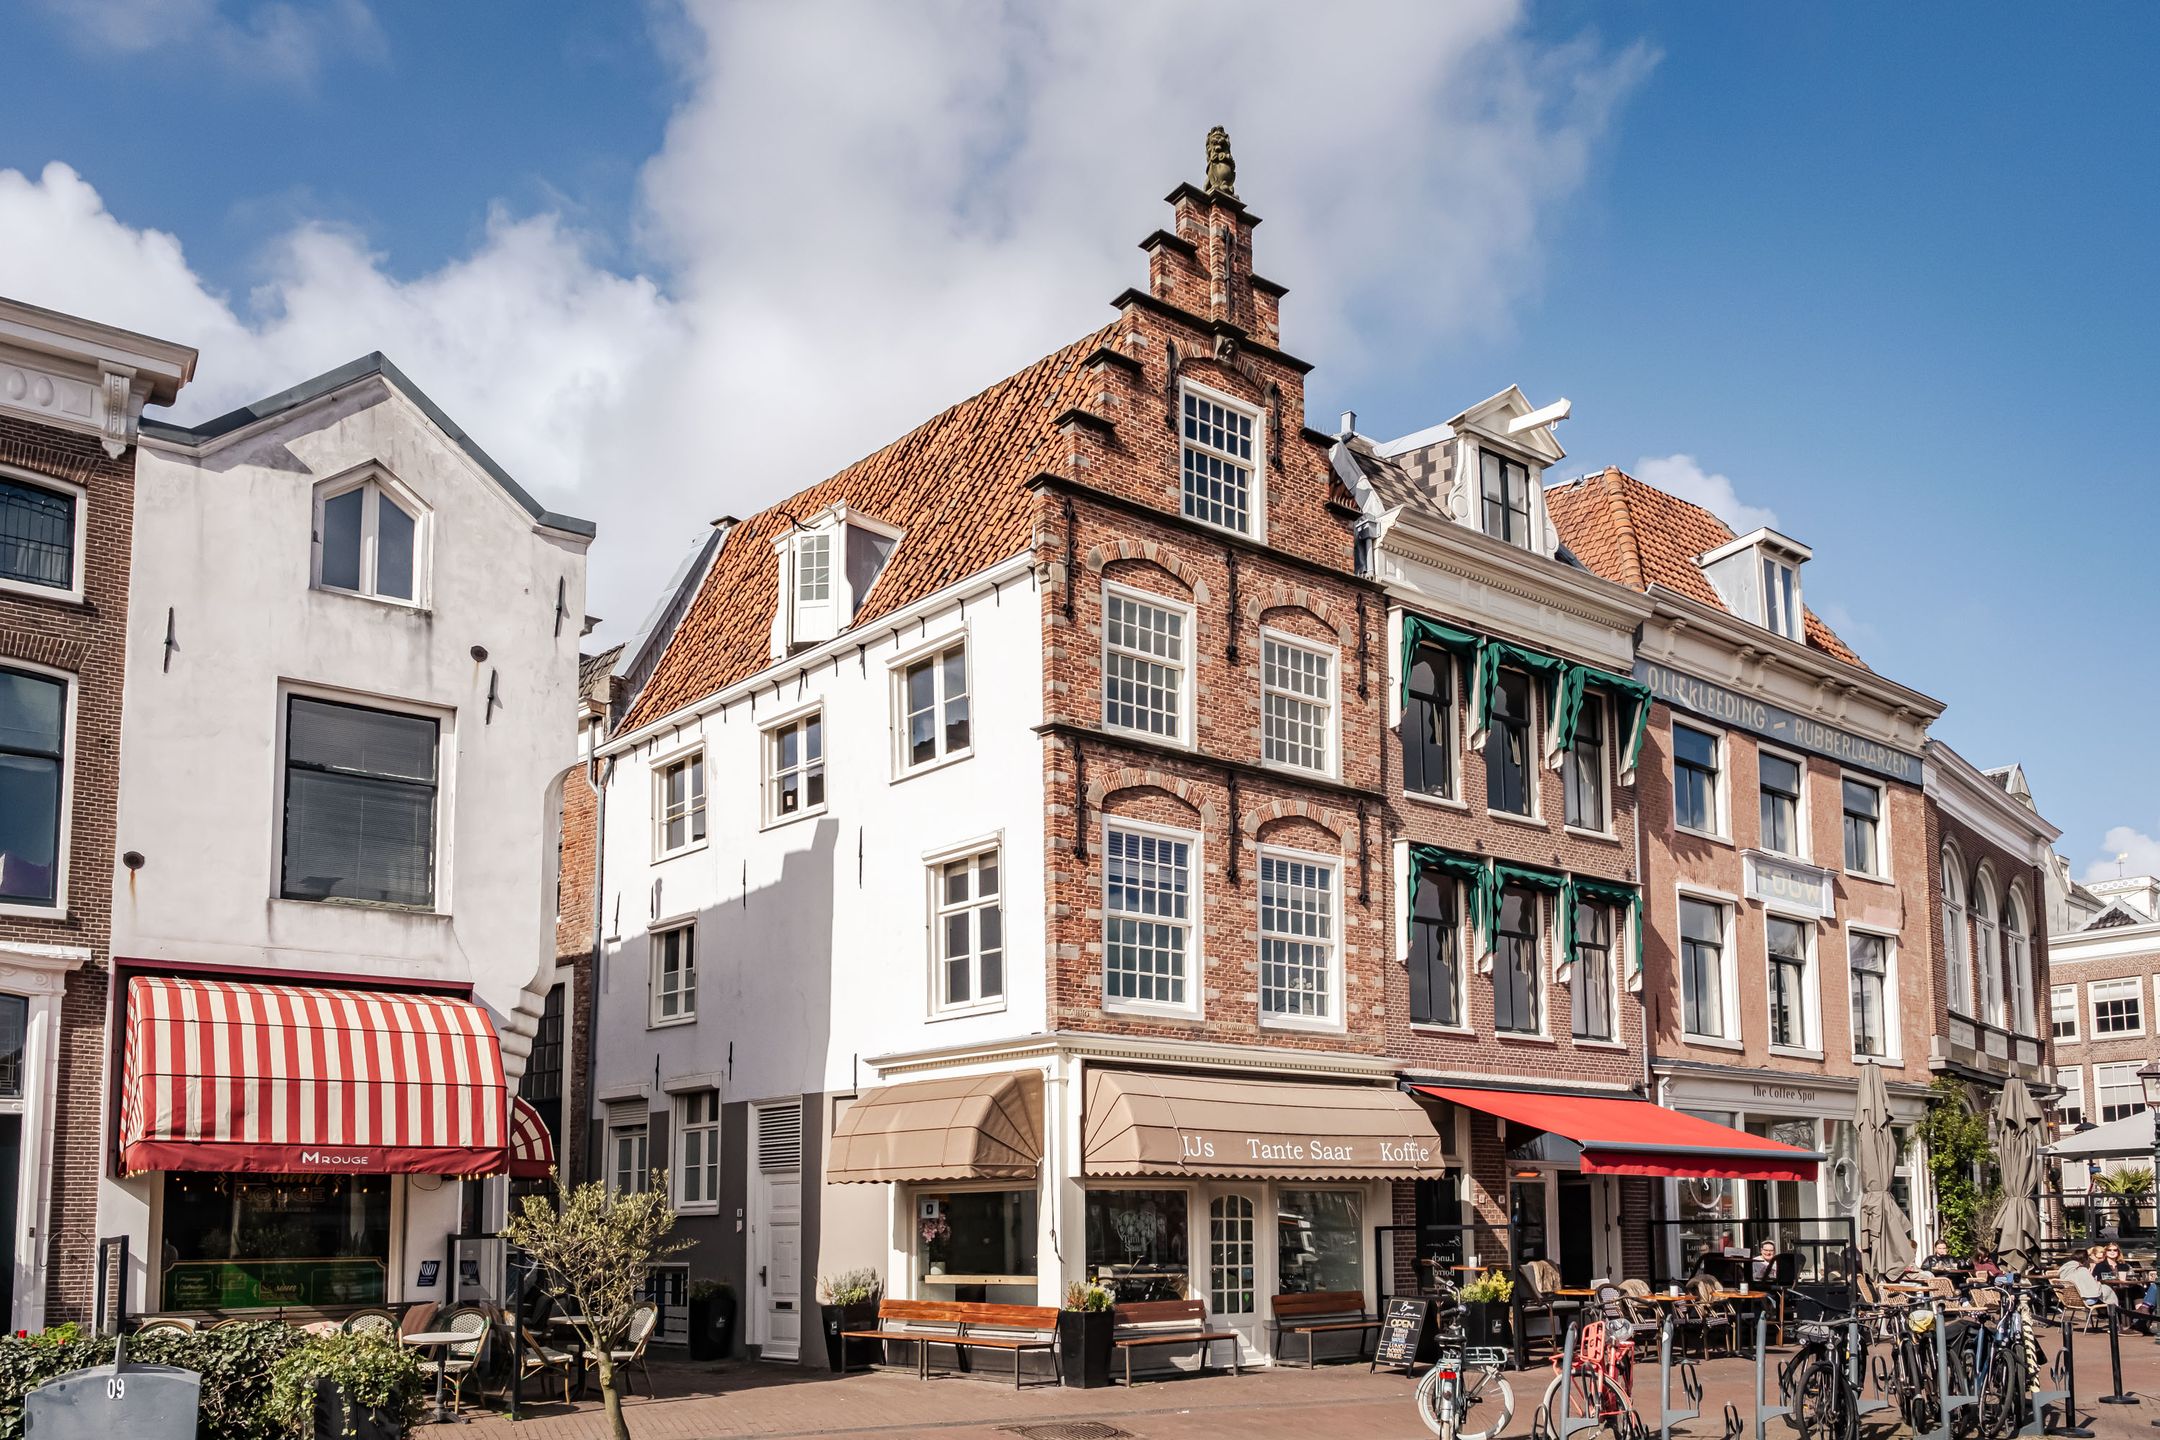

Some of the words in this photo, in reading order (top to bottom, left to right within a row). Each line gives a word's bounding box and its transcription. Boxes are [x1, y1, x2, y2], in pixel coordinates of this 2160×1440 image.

[1648, 667, 1766, 729] OLIEKLEEDING
[1795, 719, 1909, 776] RUBBERLAARZEN
[1753, 1083, 1767, 1098] The
[1769, 1087, 1796, 1100] Coffee
[1797, 1088, 1815, 1103] Spot
[1182, 1136, 1215, 1157] IJs
[1247, 1138, 1304, 1160] Tante
[1310, 1140, 1353, 1161] Saar
[1379, 1142, 1430, 1161] Koffie
[1390, 1318, 1415, 1329] OPEN
[107, 1378, 125, 1400] 09
